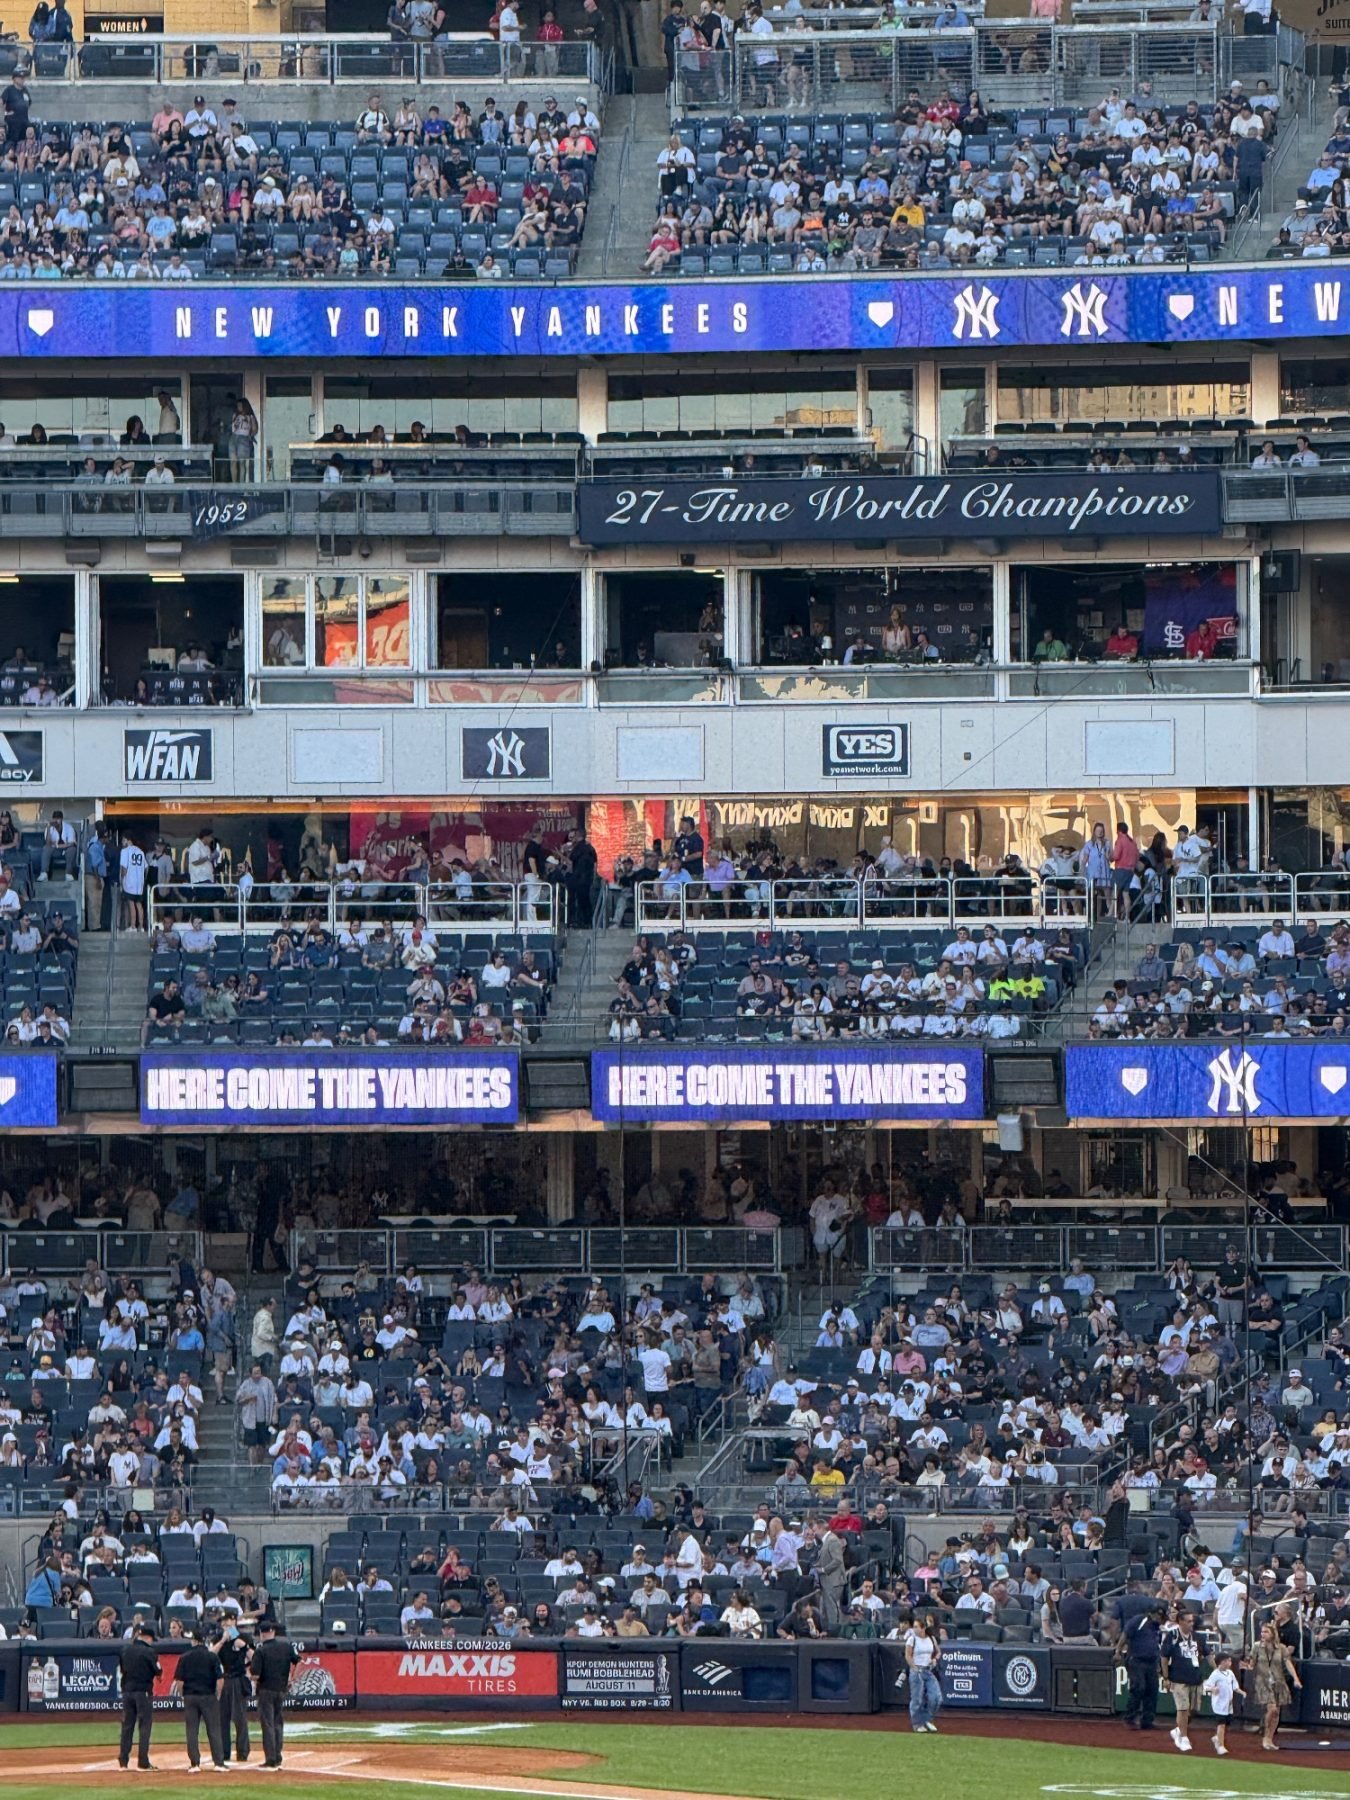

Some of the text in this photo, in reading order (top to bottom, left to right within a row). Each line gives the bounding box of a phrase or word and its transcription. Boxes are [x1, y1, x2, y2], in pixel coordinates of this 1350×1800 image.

[100, 21, 139, 32] WOMEN
[952, 284, 1000, 339] NY
[1060, 282, 1108, 336] NY
[1219, 281, 1341, 326] NEW
[176, 302, 748, 338] NEW YORK YANKEES
[195, 501, 247, 526] 1952
[605, 482, 1195, 530] 27-Time World Champions
[839, 734, 893, 754] YES
[127, 731, 201, 780] WFAN
[486, 731, 527, 776] NY
[830, 764, 902, 776] yesnetwork.com
[131, 853, 143, 866] 99
[147, 1067, 511, 1110] HERE COME THE YANKEES
[608, 1063, 967, 1106] HERE COME THE YANKEES
[1207, 1048, 1261, 1113] NY
[406, 1640, 511, 1651] YANKEES.COM/2026
[398, 1654, 516, 1677] MAXXIS
[588, 1660, 616, 1668] DEMON
[619, 1660, 655, 1668] HUNTERS
[62, 1675, 112, 1687] LEGACY
[567, 1669, 655, 1678] RUMI BOBBLEHEAD
[468, 1680, 517, 1692] TIRES
[586, 1681, 636, 1690] AUGUST 11
[712, 1689, 742, 1697] AMERICA
[152, 1701, 174, 1709] CODY
[302, 1699, 336, 1708] AUGUST
[337, 1699, 347, 1707] 21
[562, 1699, 578, 1708] NYY
